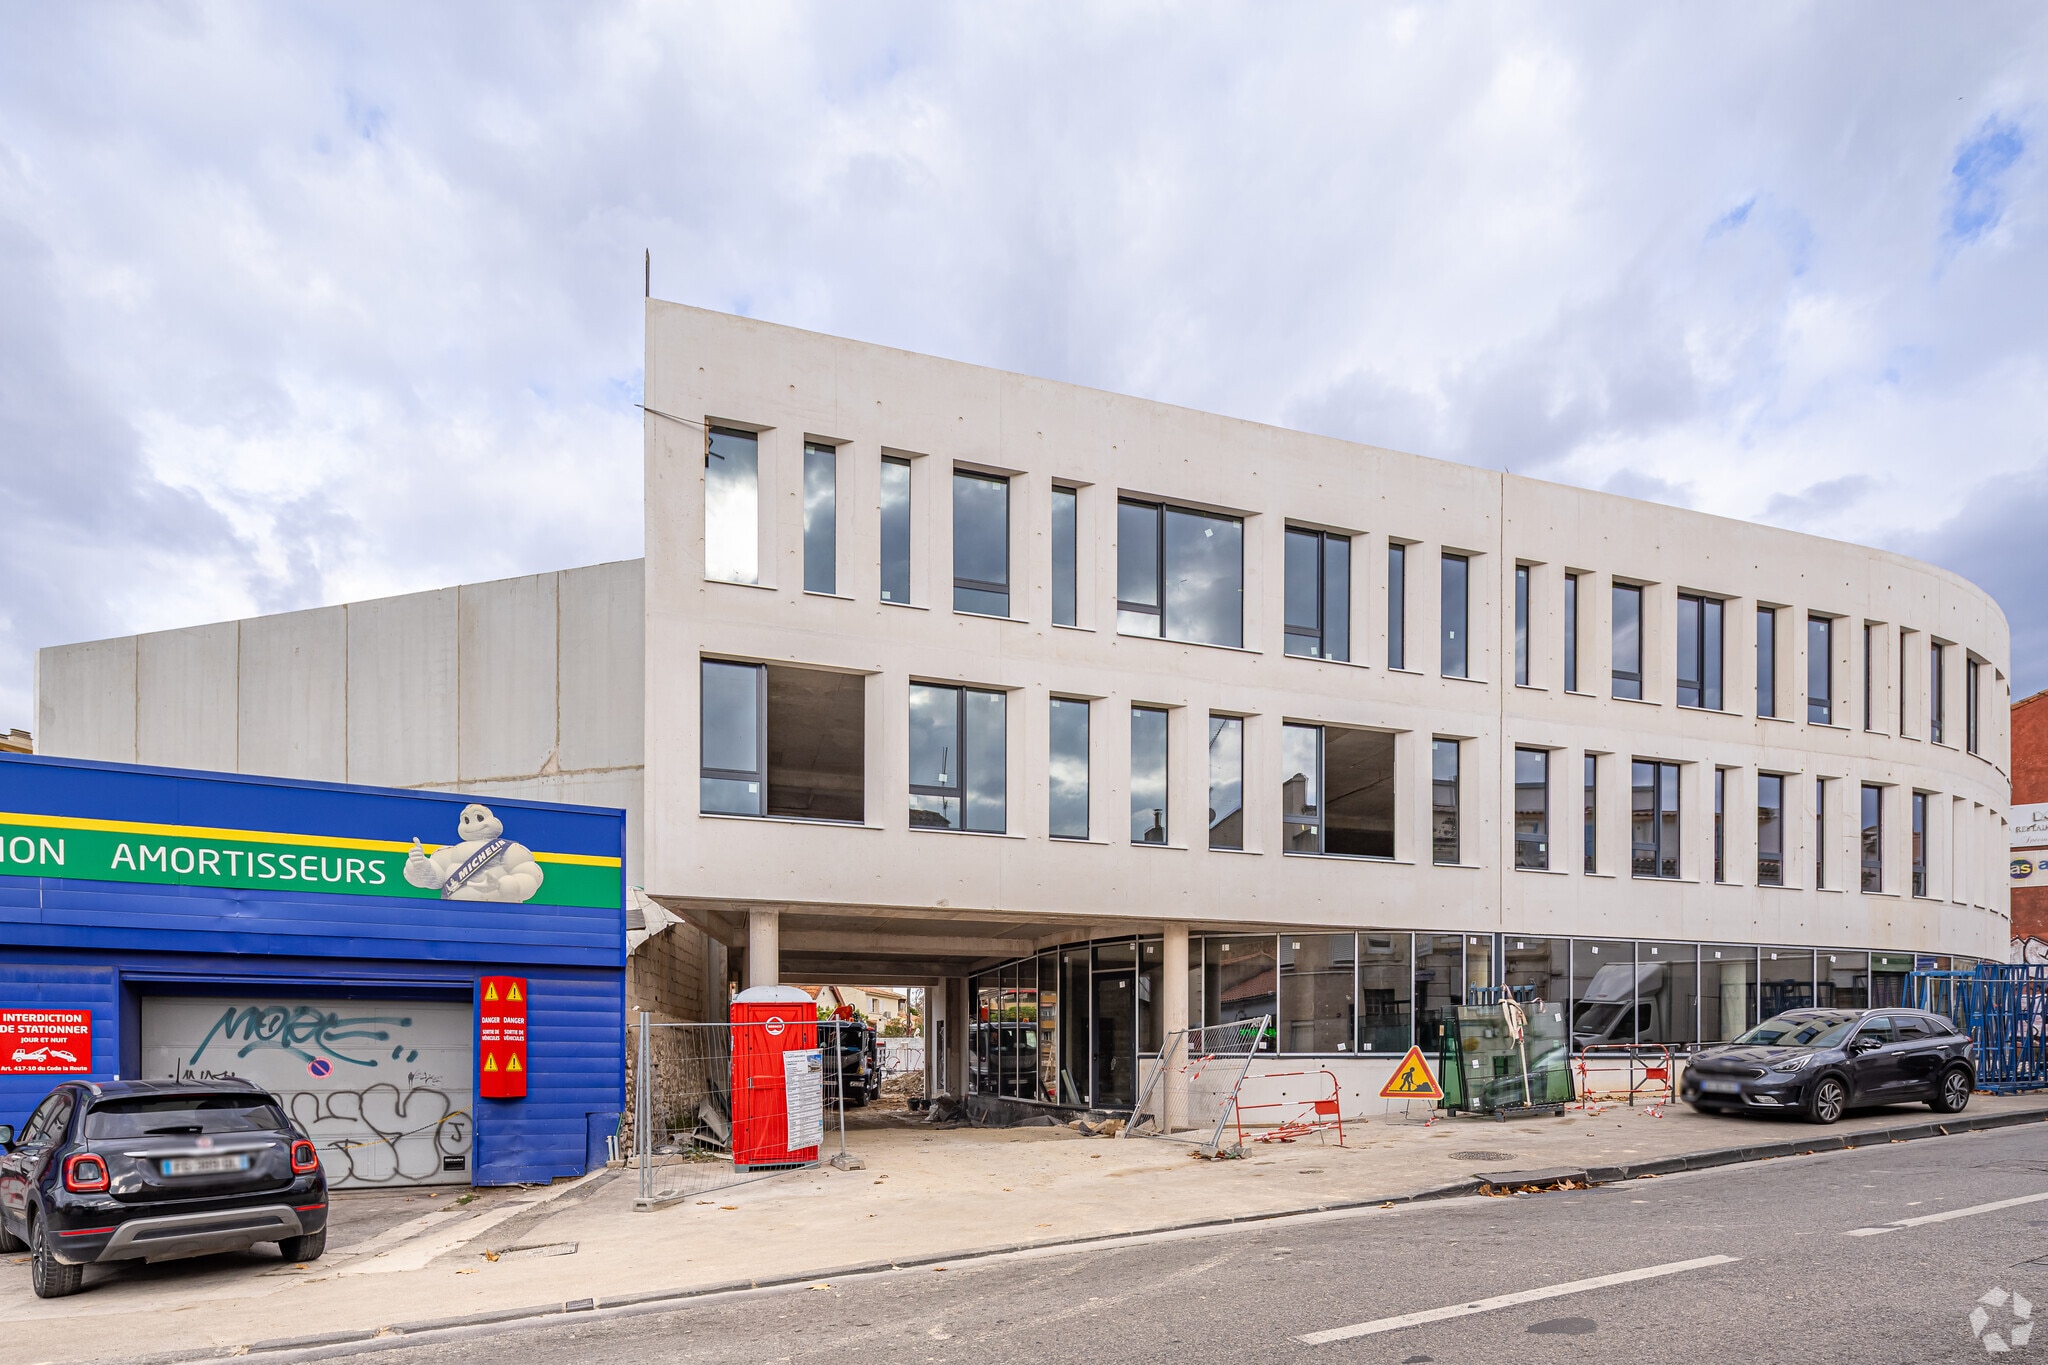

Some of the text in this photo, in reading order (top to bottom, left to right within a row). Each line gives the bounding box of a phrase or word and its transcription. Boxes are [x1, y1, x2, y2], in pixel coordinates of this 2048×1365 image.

[0, 836, 387, 885] ION AMORTISSEURS
[458, 839, 506, 881] MICHELIN
[0, 1025, 88, 1033] DE STATIONNER
[3, 1013, 82, 1022] INTERDICTION
